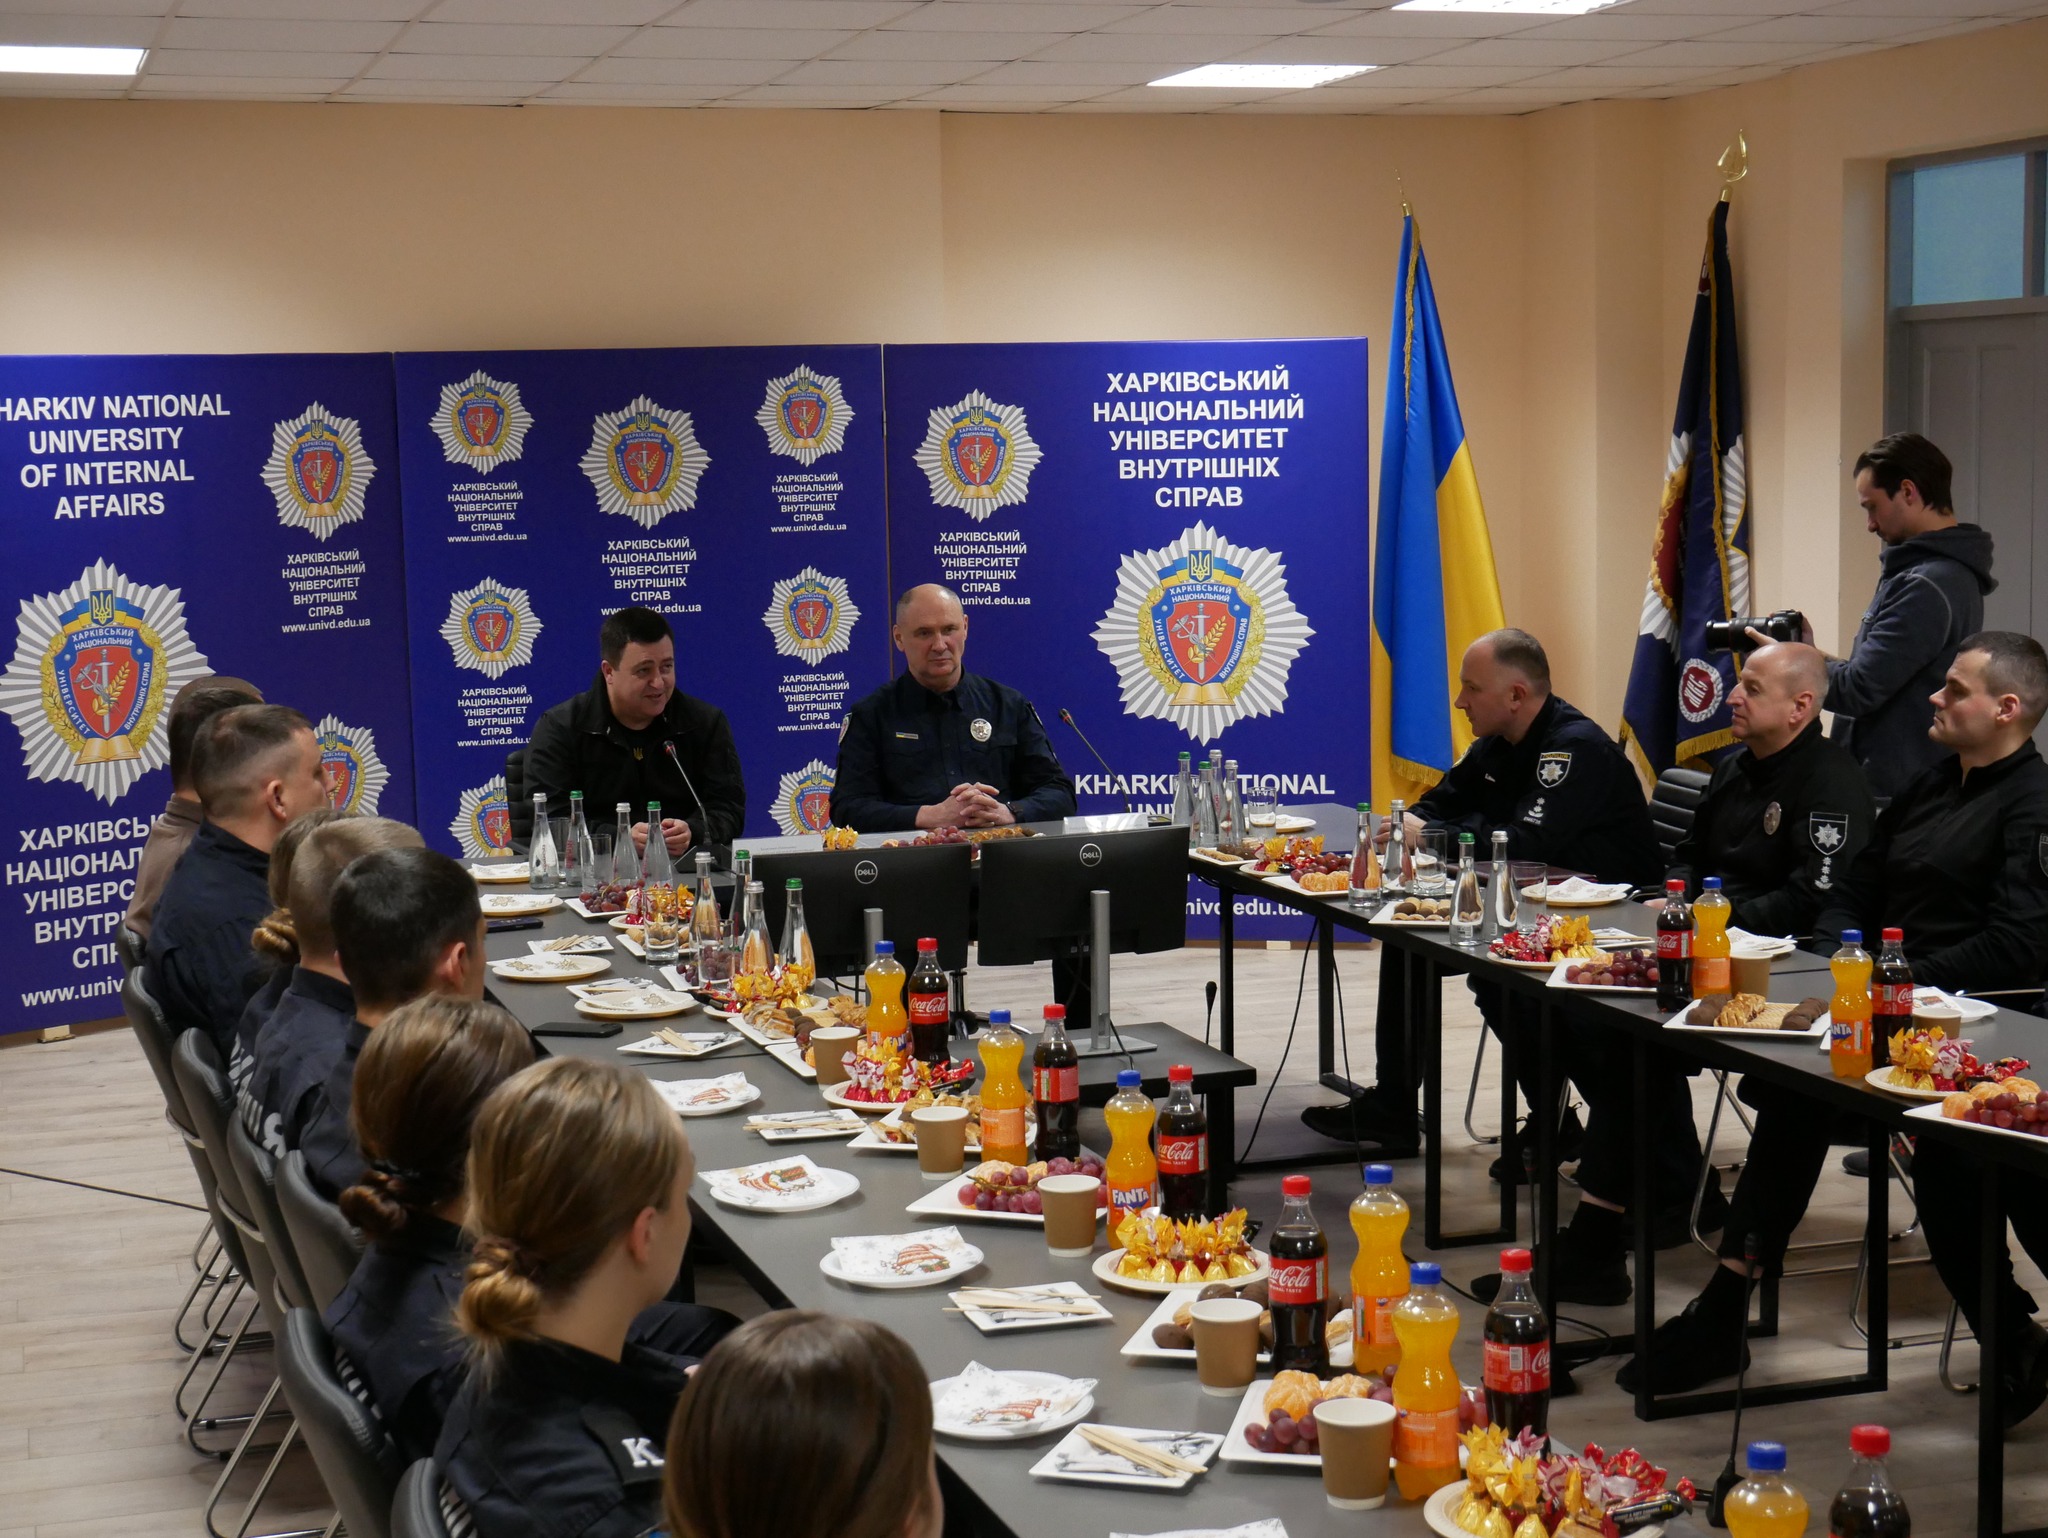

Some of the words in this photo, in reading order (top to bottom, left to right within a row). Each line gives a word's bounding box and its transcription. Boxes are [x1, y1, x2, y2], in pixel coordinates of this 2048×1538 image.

[1107, 365, 1289, 393] ХАРКІВСЬКИЙ
[103, 394, 230, 419] NATIONAL
[1094, 393, 1304, 425] НАЦІОНАЛЬНИЙ
[29, 427, 183, 454] UNIVERSITY
[1109, 428, 1289, 451] УНІВЕРСИТЕТ
[21, 464, 57, 488] OF
[65, 459, 194, 486] INTERNAL
[1119, 457, 1280, 479] ВНУТРІШНІХ
[776, 472, 841, 484] ХАРКІВСЬКИЙ
[452, 481, 518, 491] ХАРКІВСЬКИЙ
[772, 483, 843, 493] НАЦІОНАЛЬНИЙ
[448, 492, 523, 503] НАЦІОНАЛЬНИЙ
[777, 493, 838, 503] УНІВЕРСИТЕТ
[1155, 486, 1243, 507] СПРАВ
[54, 492, 165, 519] AFFAIRS
[454, 502, 518, 512] УНІВЕРСИТЕТ
[781, 503, 836, 512] ВНУТРІШНІХ
[458, 512, 515, 522] ВНУТРІШНІХ
[793, 513, 824, 522] СПРАВ
[471, 523, 503, 532] СПРАВ
[940, 530, 1020, 542] ХАРКІВСЬКИЙ
[608, 537, 689, 550] ХАРКІВСЬКИЙ
[934, 542, 1027, 556] НАЦІОНАЛЬНИЙ
[287, 549, 359, 564] ХАРКІВСЬКИЙ
[602, 551, 697, 564] НАЦІОНАЛЬНИЙ
[941, 557, 1020, 567] УНІВЕРСИТЕТ
[282, 563, 365, 579] НАЦІОНАЛЬНИЙ
[609, 564, 690, 576] УНІВЕРСИТЕТ
[946, 570, 1016, 580] ВНУТРІШНІХ
[289, 577, 360, 592] УНІВЕРСИТЕТ
[614, 577, 687, 589] ВНУТРІШНІХ
[962, 583, 1001, 592] СПРАВ
[1168, 583, 1232, 595] ХАРКІВСЬКИЙ
[293, 590, 357, 605] ВНУТРІШНІХ
[631, 591, 671, 601] СПРАВ
[1171, 592, 1230, 604] НАЦІОНАЛЬНИЙ
[308, 605, 344, 617] СПРАВ
[71, 626, 135, 643] ХАРКІВСЬКИЙ
[1236, 617, 1248, 642] СПРАВ
[74, 637, 133, 651] НАЦІОНАЛЬНИЙ
[1154, 618, 1185, 680] УНІВЕРСИТЕТ
[140, 661, 151, 688] СПРАВ
[783, 672, 848, 683] ХАРКІВСЬКИЙ
[462, 685, 527, 697] ХАРКІВСЬКИЙ
[778, 682, 849, 693] НАЦІОНАЛЬНИЙ
[57, 669, 91, 736] УНІВЕРСИТЕТ
[458, 694, 532, 707] НАЦІОНАЛЬНИЙ
[784, 692, 844, 702] УНІВЕРСИТЕТ
[464, 706, 527, 717] УНІВЕРСИТЕТ
[788, 702, 842, 712] ВНУТРІШНІХ
[468, 716, 525, 726] ВНУТРІШНІХ
[800, 712, 830, 721] СПРАВ
[481, 727, 512, 736] СПРАВ
[1075, 773, 1186, 796] KHARKI
[19, 813, 163, 852] ХАРКІВСЬ
[1082, 851, 1101, 859] DELL
[910, 996, 947, 1013] Coca-Cola
[1112, 1187, 1149, 1205] FANTA
